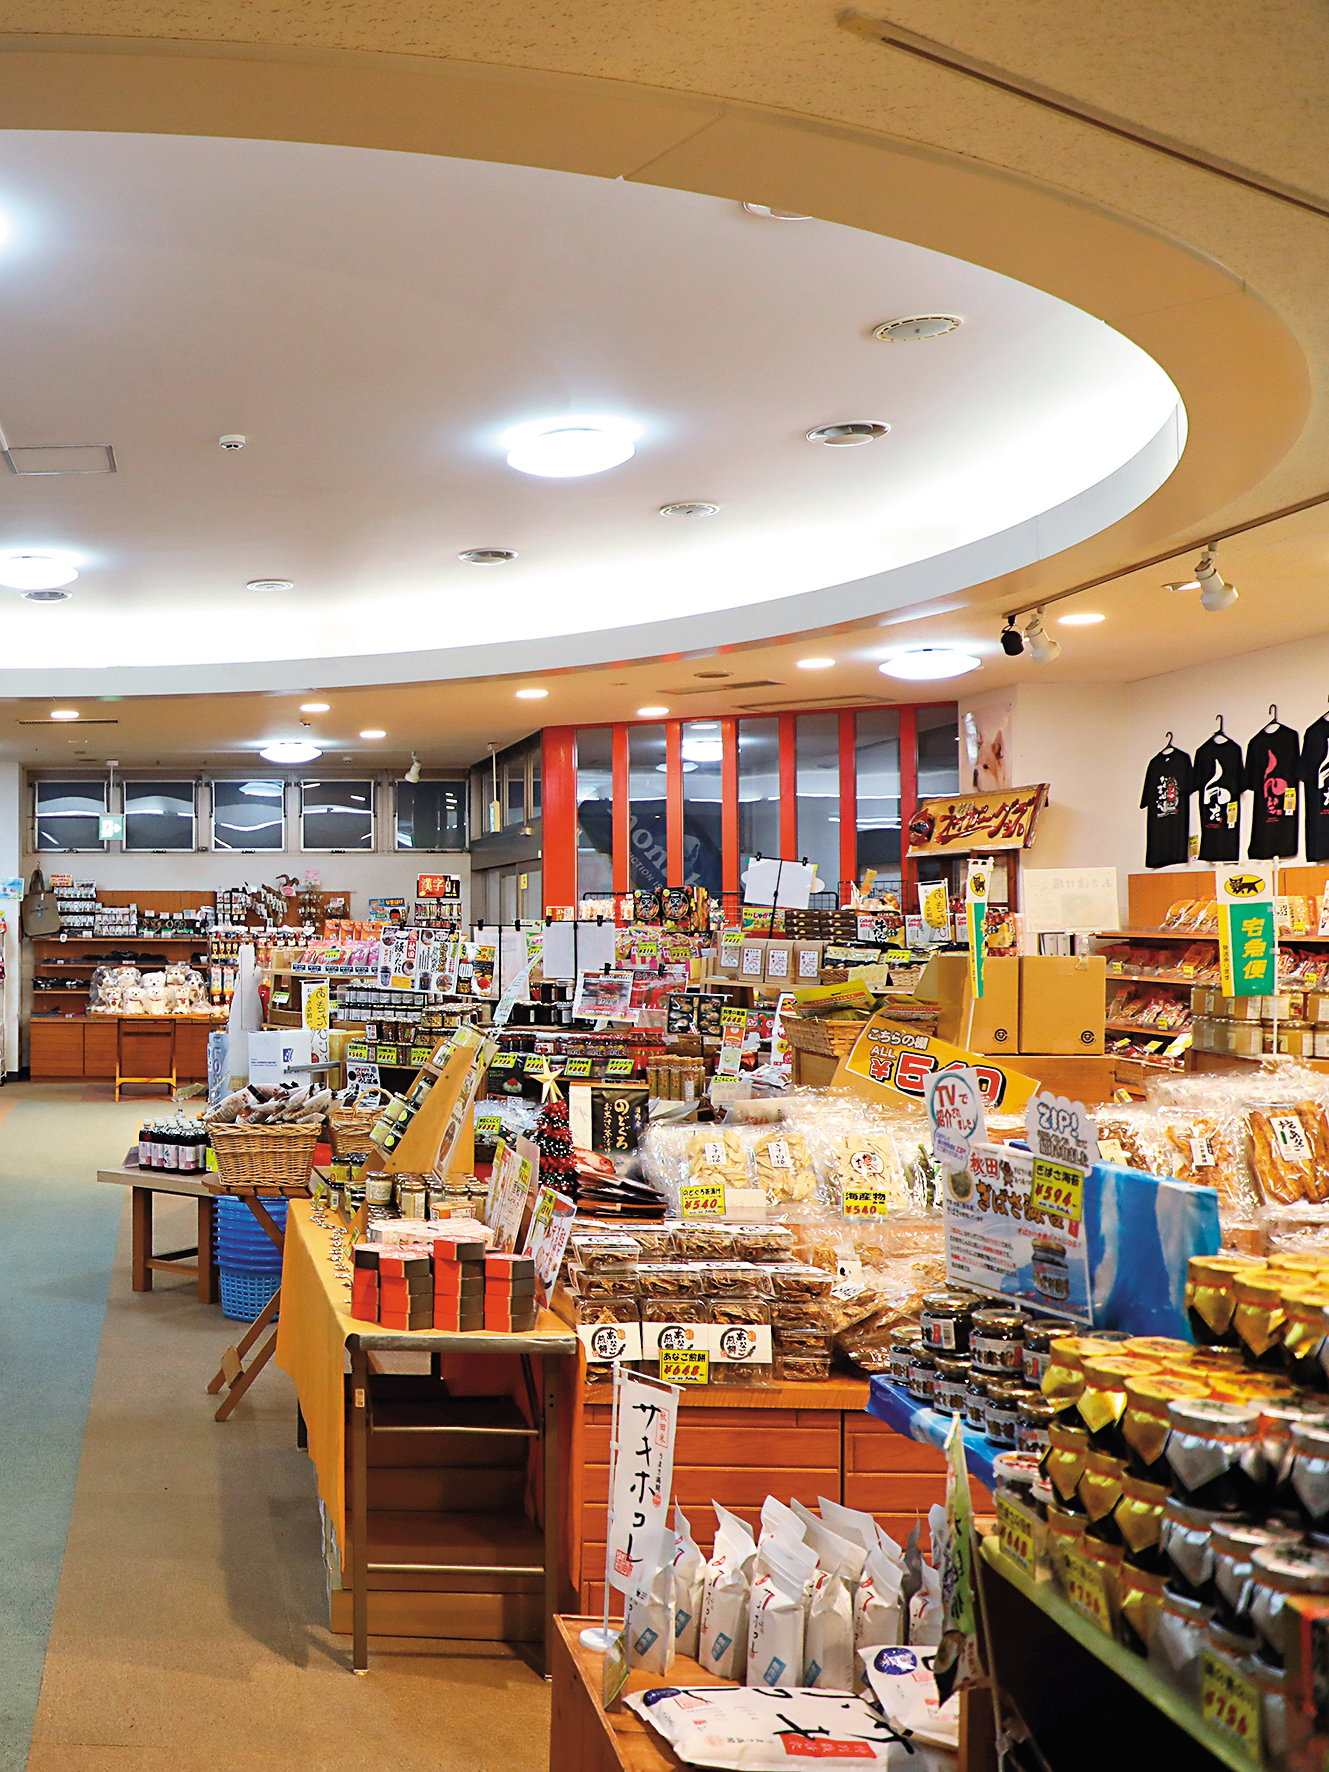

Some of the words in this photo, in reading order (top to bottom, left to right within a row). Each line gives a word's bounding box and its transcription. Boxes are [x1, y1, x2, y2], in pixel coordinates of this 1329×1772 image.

[422, 877, 444, 892] 漢字
[1241, 917, 1268, 980] 宅急便
[867, 1027, 930, 1051] こちらの棚
[870, 1045, 897, 1059] ALL
[614, 1098, 630, 1150] のどぐろ
[1037, 1101, 1080, 1139] ZIP!
[970, 1151, 1000, 1177] 秋田
[1036, 1164, 1080, 1187] ぎばさ海苔
[683, 1187, 721, 1196] のどぐろ茶漬け
[845, 1191, 886, 1201] 海産物
[1035, 1182, 1073, 1207] ¥594
[684, 1199, 718, 1210] ¥540
[845, 1205, 877, 1215] ¥540
[673, 1328, 685, 1350] あな
[663, 1352, 706, 1362] あなご煎餅
[664, 1364, 701, 1376] ¥648
[658, 1411, 668, 1445] 秋田米
[629, 1403, 662, 1563] サキホコレ
